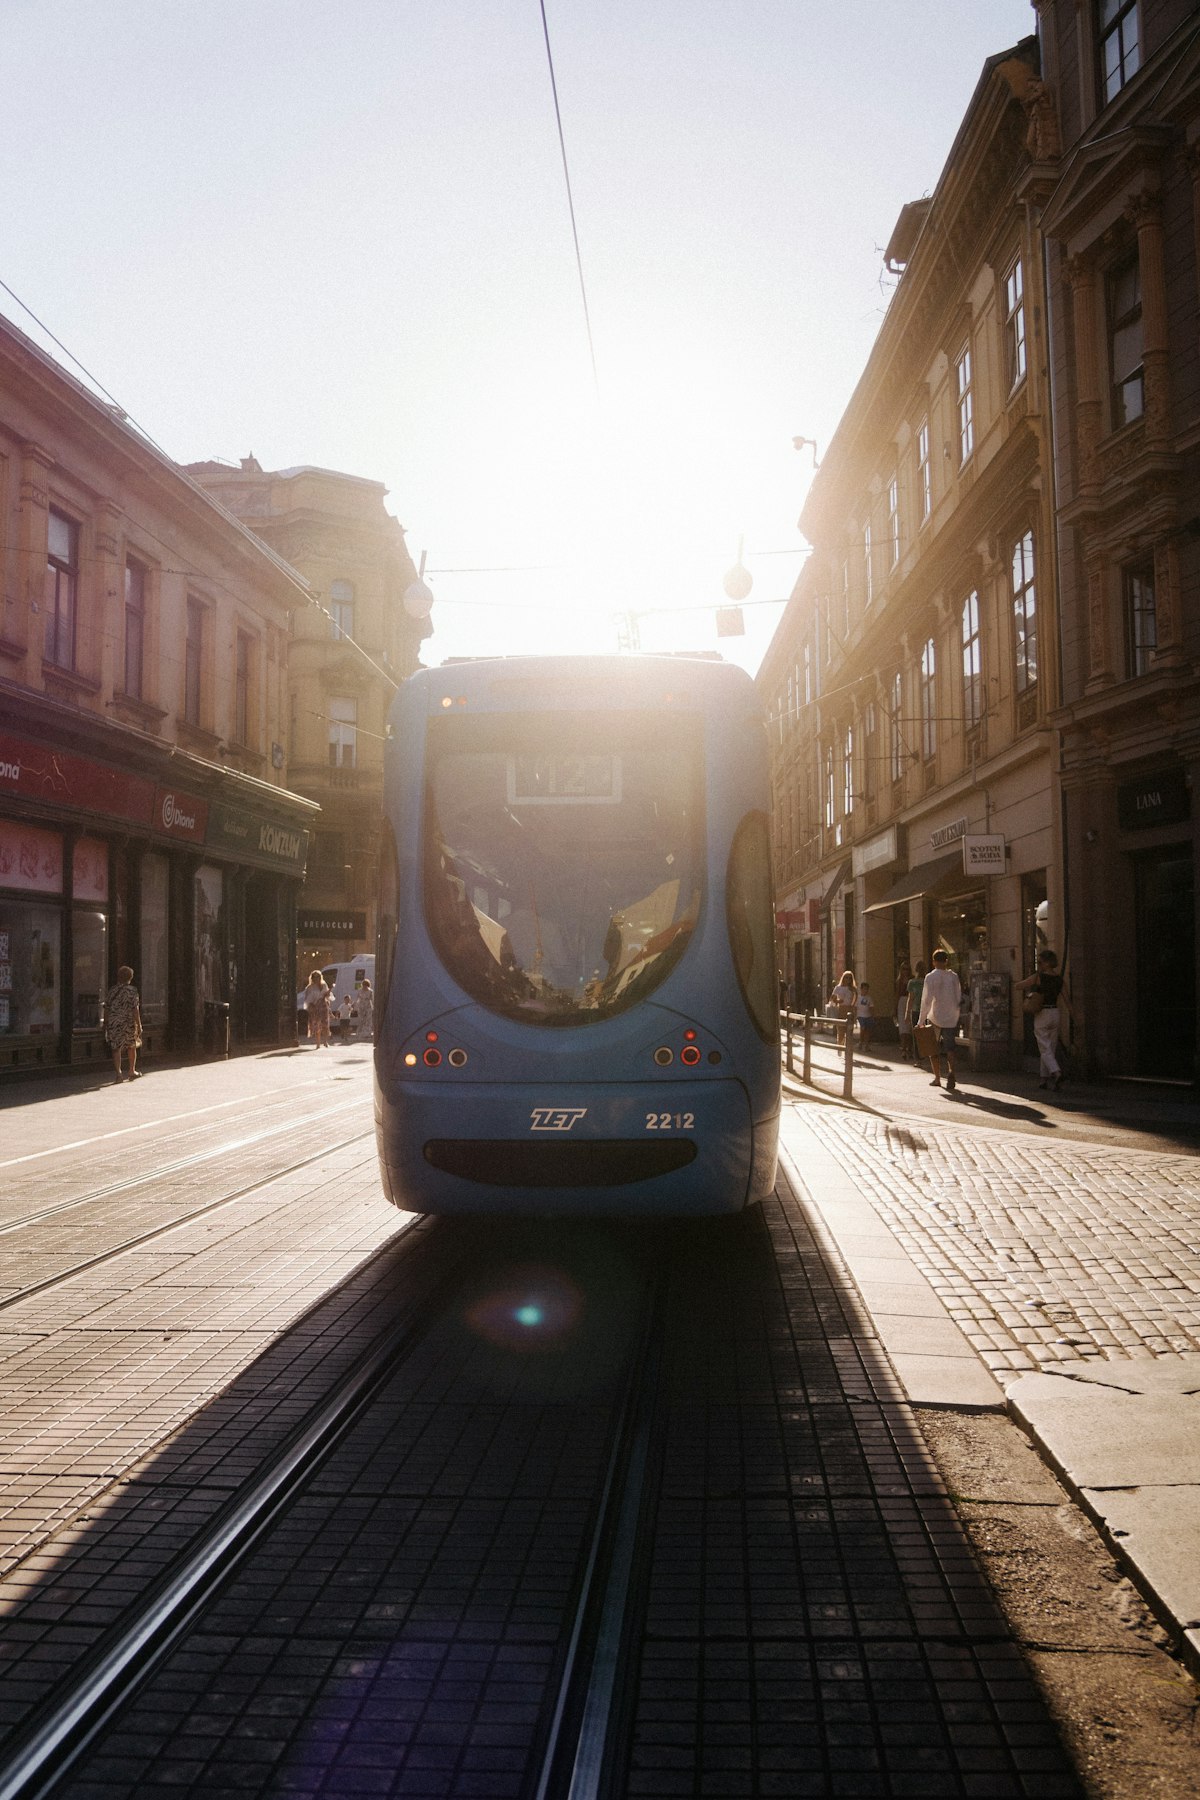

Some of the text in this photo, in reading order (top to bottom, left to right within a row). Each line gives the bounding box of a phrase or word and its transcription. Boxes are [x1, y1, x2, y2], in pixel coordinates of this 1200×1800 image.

[1136, 792, 1162, 810] LANA
[258, 824, 300, 859] KONZUM
[530, 1108, 588, 1130] ZET
[645, 1112, 695, 1129] 2212
